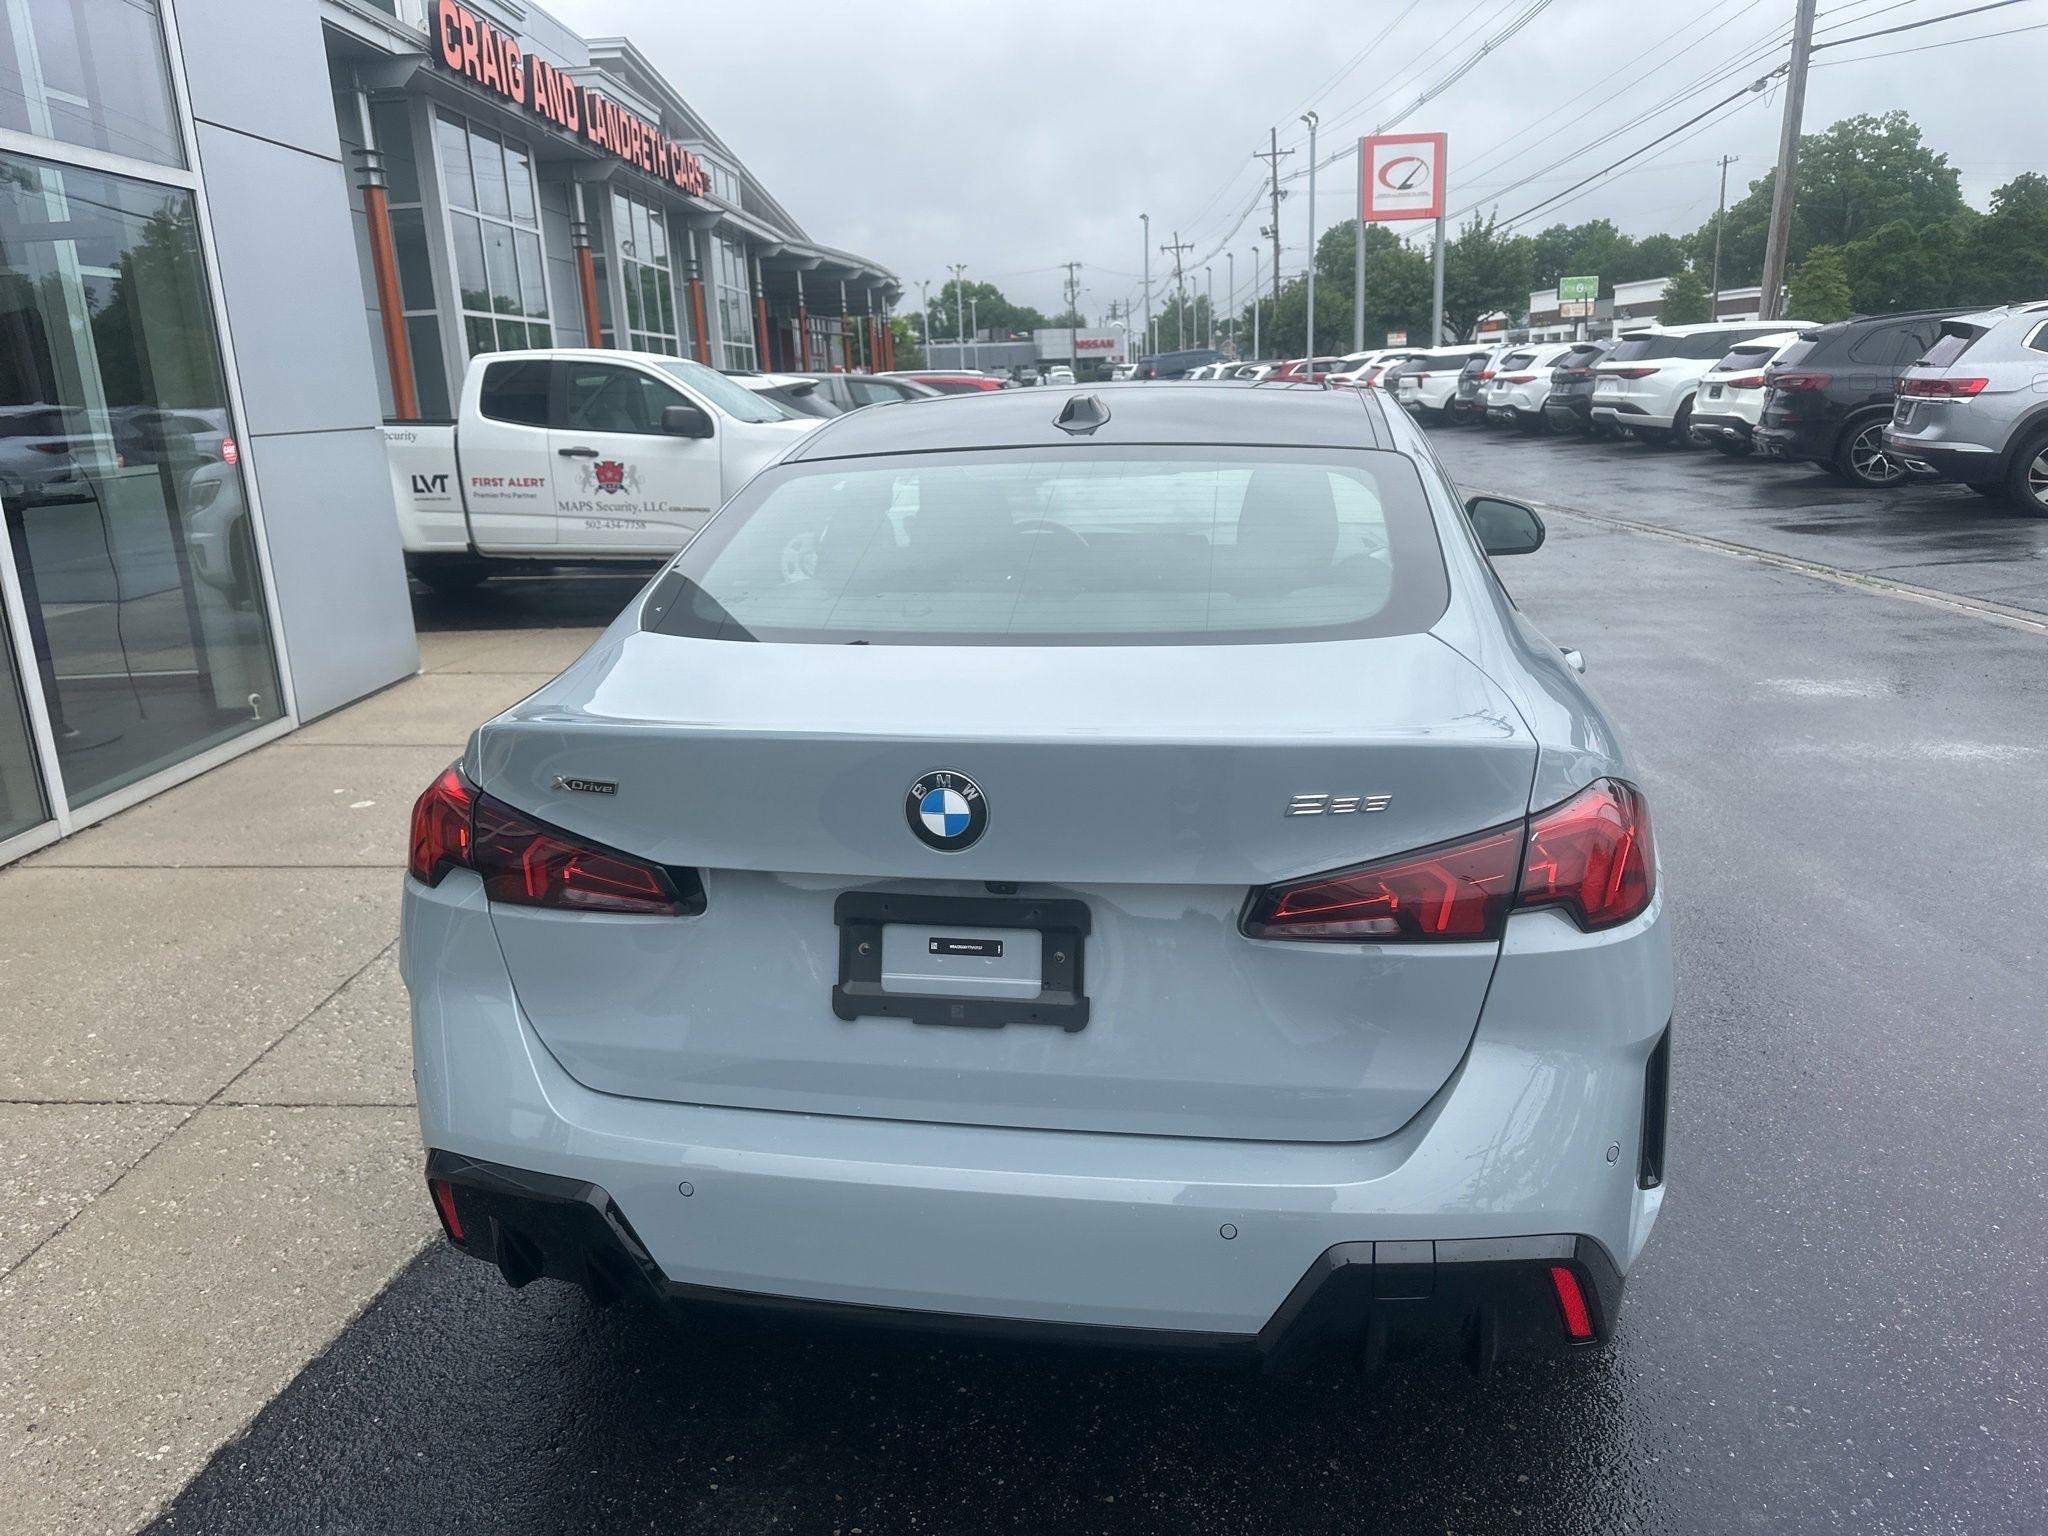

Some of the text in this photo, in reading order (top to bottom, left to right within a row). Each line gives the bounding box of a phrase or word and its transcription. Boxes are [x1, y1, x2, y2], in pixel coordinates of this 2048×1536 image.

[438, 0, 704, 197] CRAIG AND LANDRETH CARS
[384, 432, 417, 443] ecurity
[411, 474, 449, 493] LVT
[472, 477, 545, 487] FIRST ALERT
[558, 500, 594, 512] MAPS
[596, 500, 642, 515] Security,
[644, 501, 668, 512] LLC
[911, 773, 980, 801] BMW
